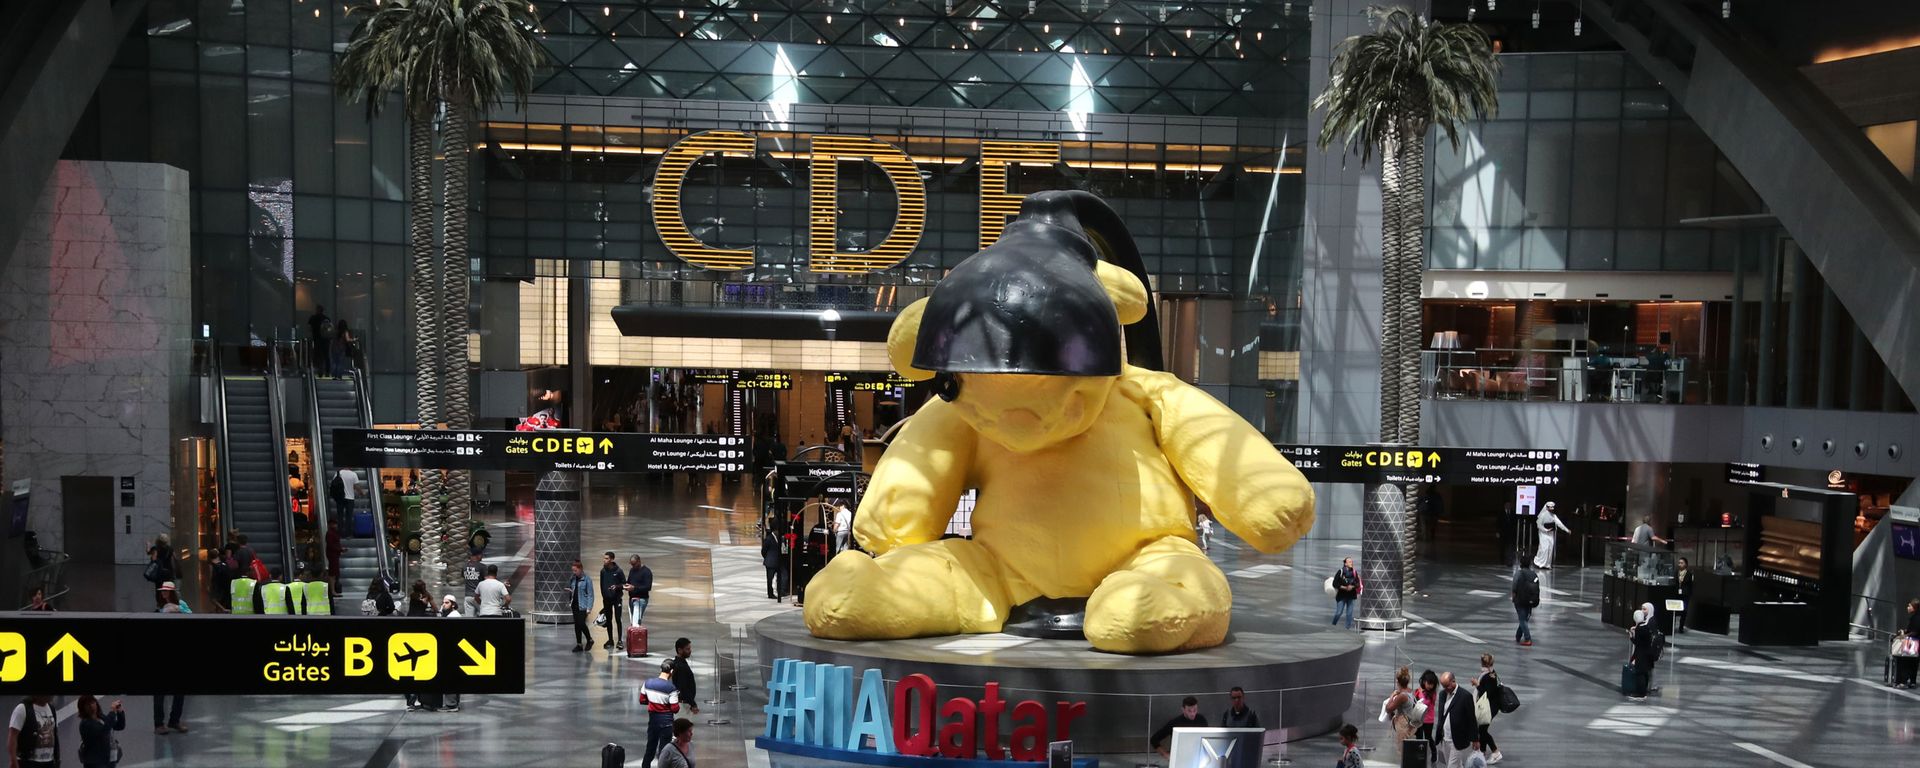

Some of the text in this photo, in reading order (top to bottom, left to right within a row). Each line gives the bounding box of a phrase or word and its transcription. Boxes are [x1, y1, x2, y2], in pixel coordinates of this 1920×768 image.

[652, 130, 757, 271] C
[809, 134, 927, 274] D
[264, 637, 374, 681] Gates B
[274, 634, 330, 657] بوابات
